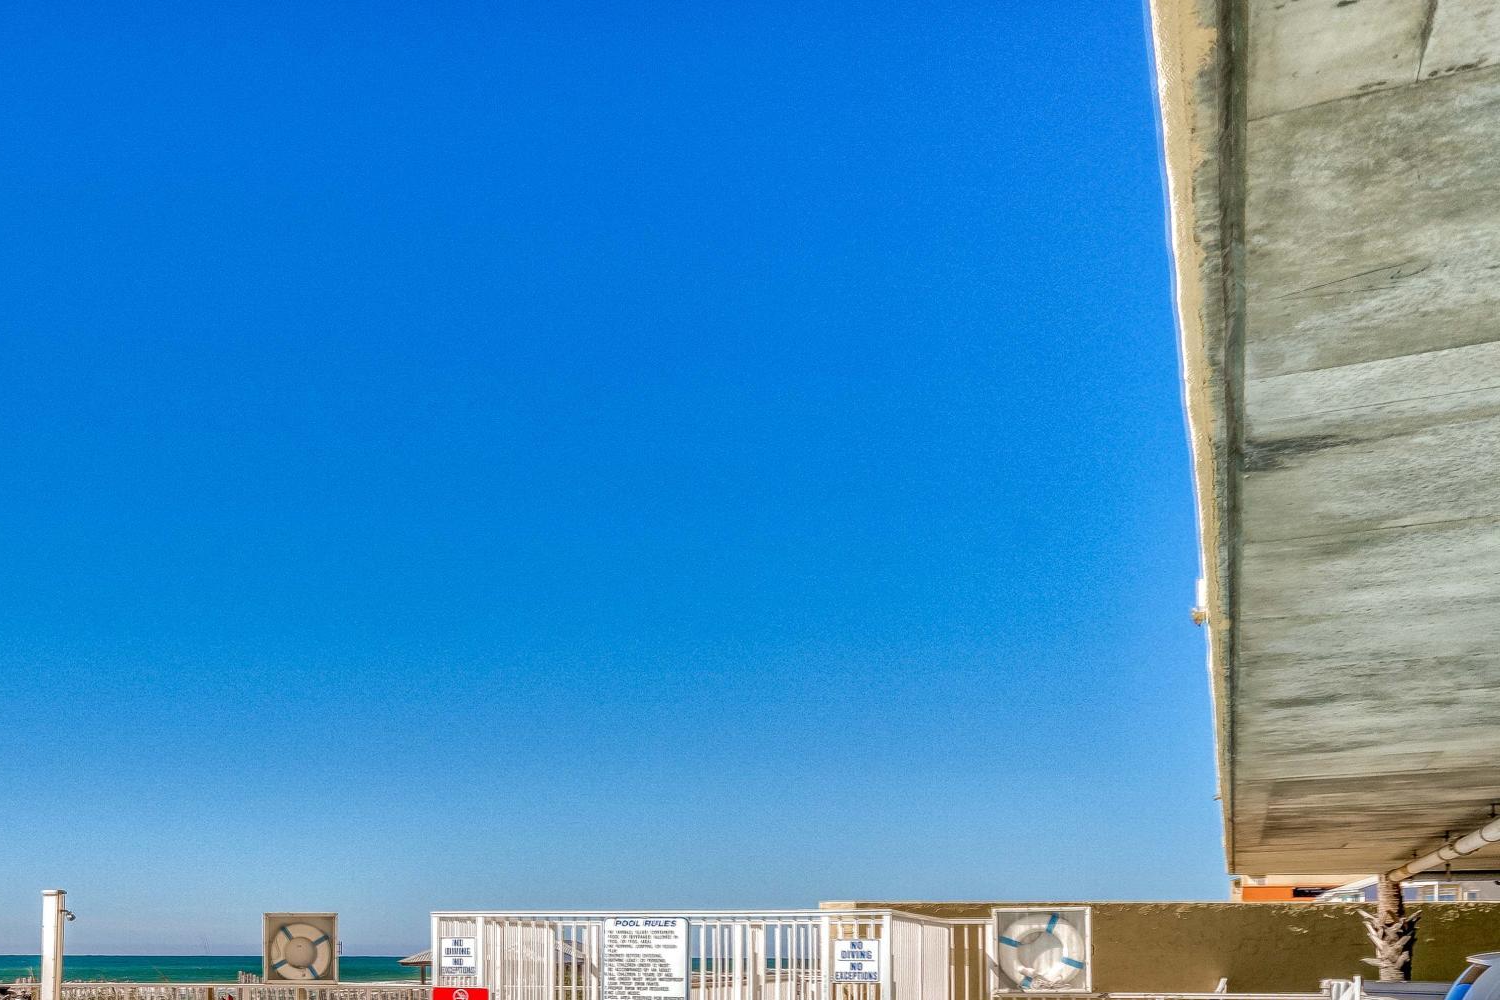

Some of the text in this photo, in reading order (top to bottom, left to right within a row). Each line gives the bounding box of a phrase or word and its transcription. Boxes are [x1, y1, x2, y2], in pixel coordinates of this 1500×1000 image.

[615, 919, 677, 927] POOL RULES
[452, 939, 464, 947] NO
[850, 941, 863, 950] NO
[445, 947, 471, 955] DIVING
[841, 950, 872, 959] DIVING
[452, 958, 464, 966] NO
[850, 962, 863, 971] NO
[835, 971, 878, 980] EXCEPTIONS
